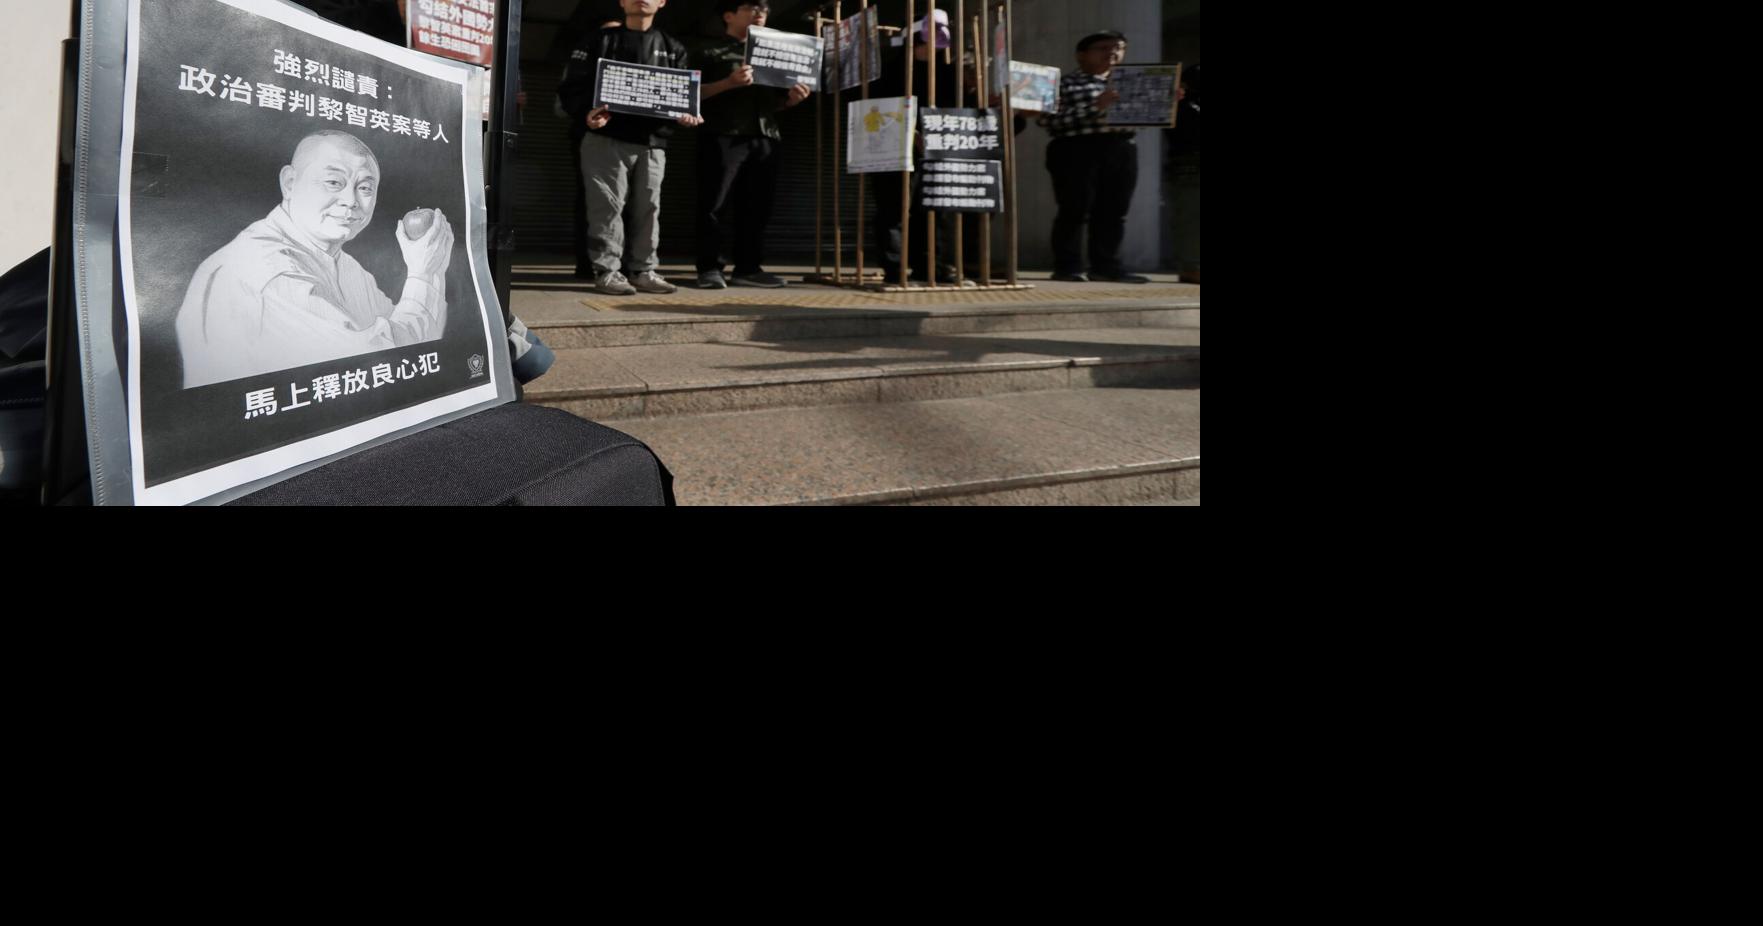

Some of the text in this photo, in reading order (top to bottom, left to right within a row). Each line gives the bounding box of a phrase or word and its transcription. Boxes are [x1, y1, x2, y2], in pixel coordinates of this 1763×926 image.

[418, 15, 494, 45] 黎智英案重判20
[273, 48, 393, 99] 強烈譴責：
[178, 64, 449, 144] 政治審判黎智英案等人
[924, 133, 1000, 151] 重判20年
[244, 351, 441, 420] 馬上釋放良心犯
